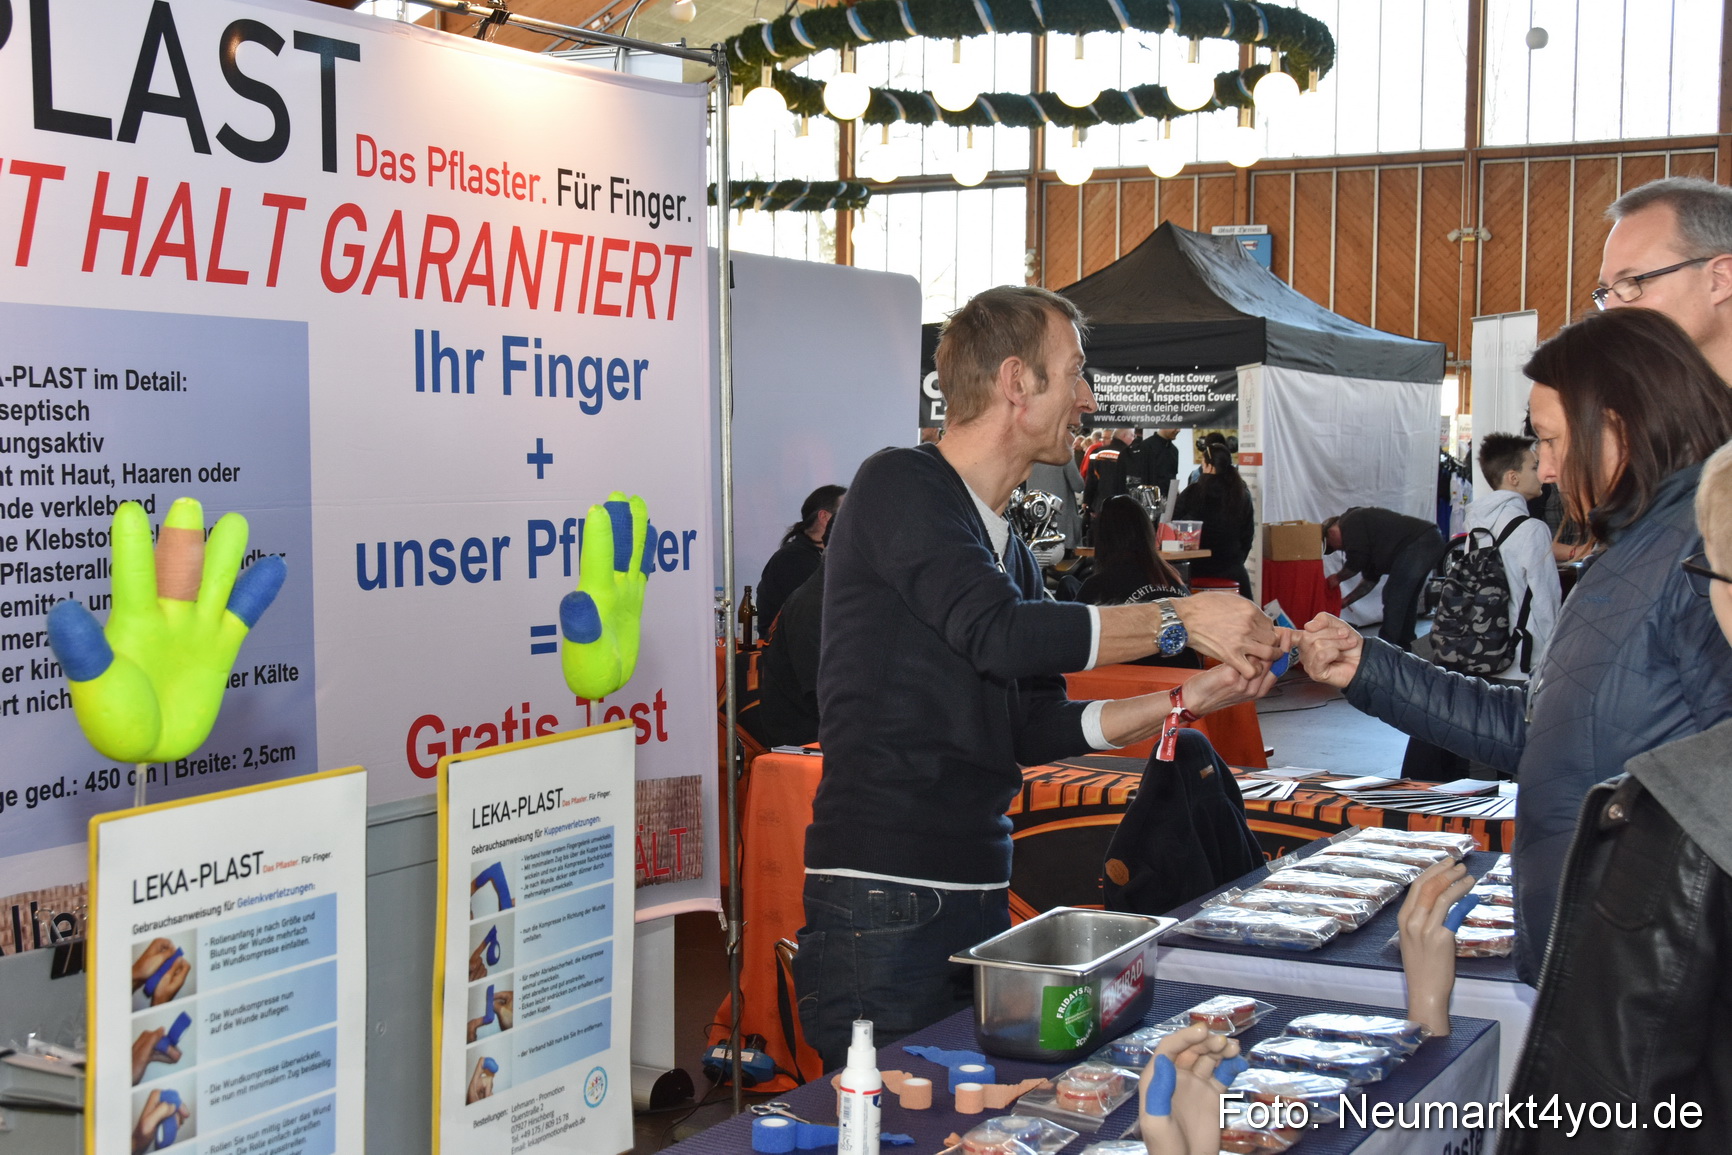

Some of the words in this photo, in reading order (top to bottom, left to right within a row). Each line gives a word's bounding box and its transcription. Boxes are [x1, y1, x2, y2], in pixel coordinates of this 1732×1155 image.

[0, 0, 361, 173] LAST
[356, 134, 416, 184] Das
[428, 146, 547, 204] Pflaster.
[557, 167, 603, 212] Für
[611, 176, 692, 229] Finger.
[81, 170, 307, 287] HALT
[319, 201, 692, 320] GARANTIERT
[94, 368, 118, 390] im
[125, 369, 187, 392] Detail:
[414, 329, 485, 394] Ihr
[502, 335, 649, 415] Finger
[1093, 373, 1123, 385] Derby
[1125, 373, 1156, 384] Cover,
[1158, 373, 1184, 383] Point
[1187, 373, 1218, 384] Cover,
[1094, 383, 1155, 394] Hupencover,
[1157, 383, 1212, 393] Achscover,
[1094, 393, 1150, 403] Tankdeckel,
[1153, 393, 1206, 404] Inspection
[1207, 391, 1239, 402] Cover.
[1094, 414, 1183, 424] www.covershop24.de
[1110, 404, 1151, 414] gravieren
[1156, 403, 1178, 412] deine
[1181, 403, 1205, 412] Ideen
[20, 464, 54, 486] mit
[62, 463, 115, 488] Haut,
[122, 463, 191, 484] Haaren
[198, 462, 240, 483] oder
[41, 494, 155, 518] verklebd
[356, 530, 510, 591] unser
[254, 663, 299, 685] Kälte
[406, 701, 559, 779] Gratis
[85, 767, 121, 793] 450
[175, 754, 236, 779] Breite:
[243, 745, 296, 769] 2,5cm
[472, 787, 562, 829] LEKA-PLAST
[471, 830, 533, 856] Gebrauchsanweisung
[534, 828, 542, 838] für
[132, 850, 263, 904] LEKA-PLAST
[301, 854, 311, 863] Für
[313, 849, 332, 862] Finger.
[132, 902, 221, 937] Gebrauchsanweisung
[223, 899, 234, 912] für
[237, 879, 315, 910] Gelenkverletzungen:
[1056, 987, 1084, 1019] FRIDAYS
[538, 1083, 564, 1102] Promotion
[540, 1102, 543, 1111] 2
